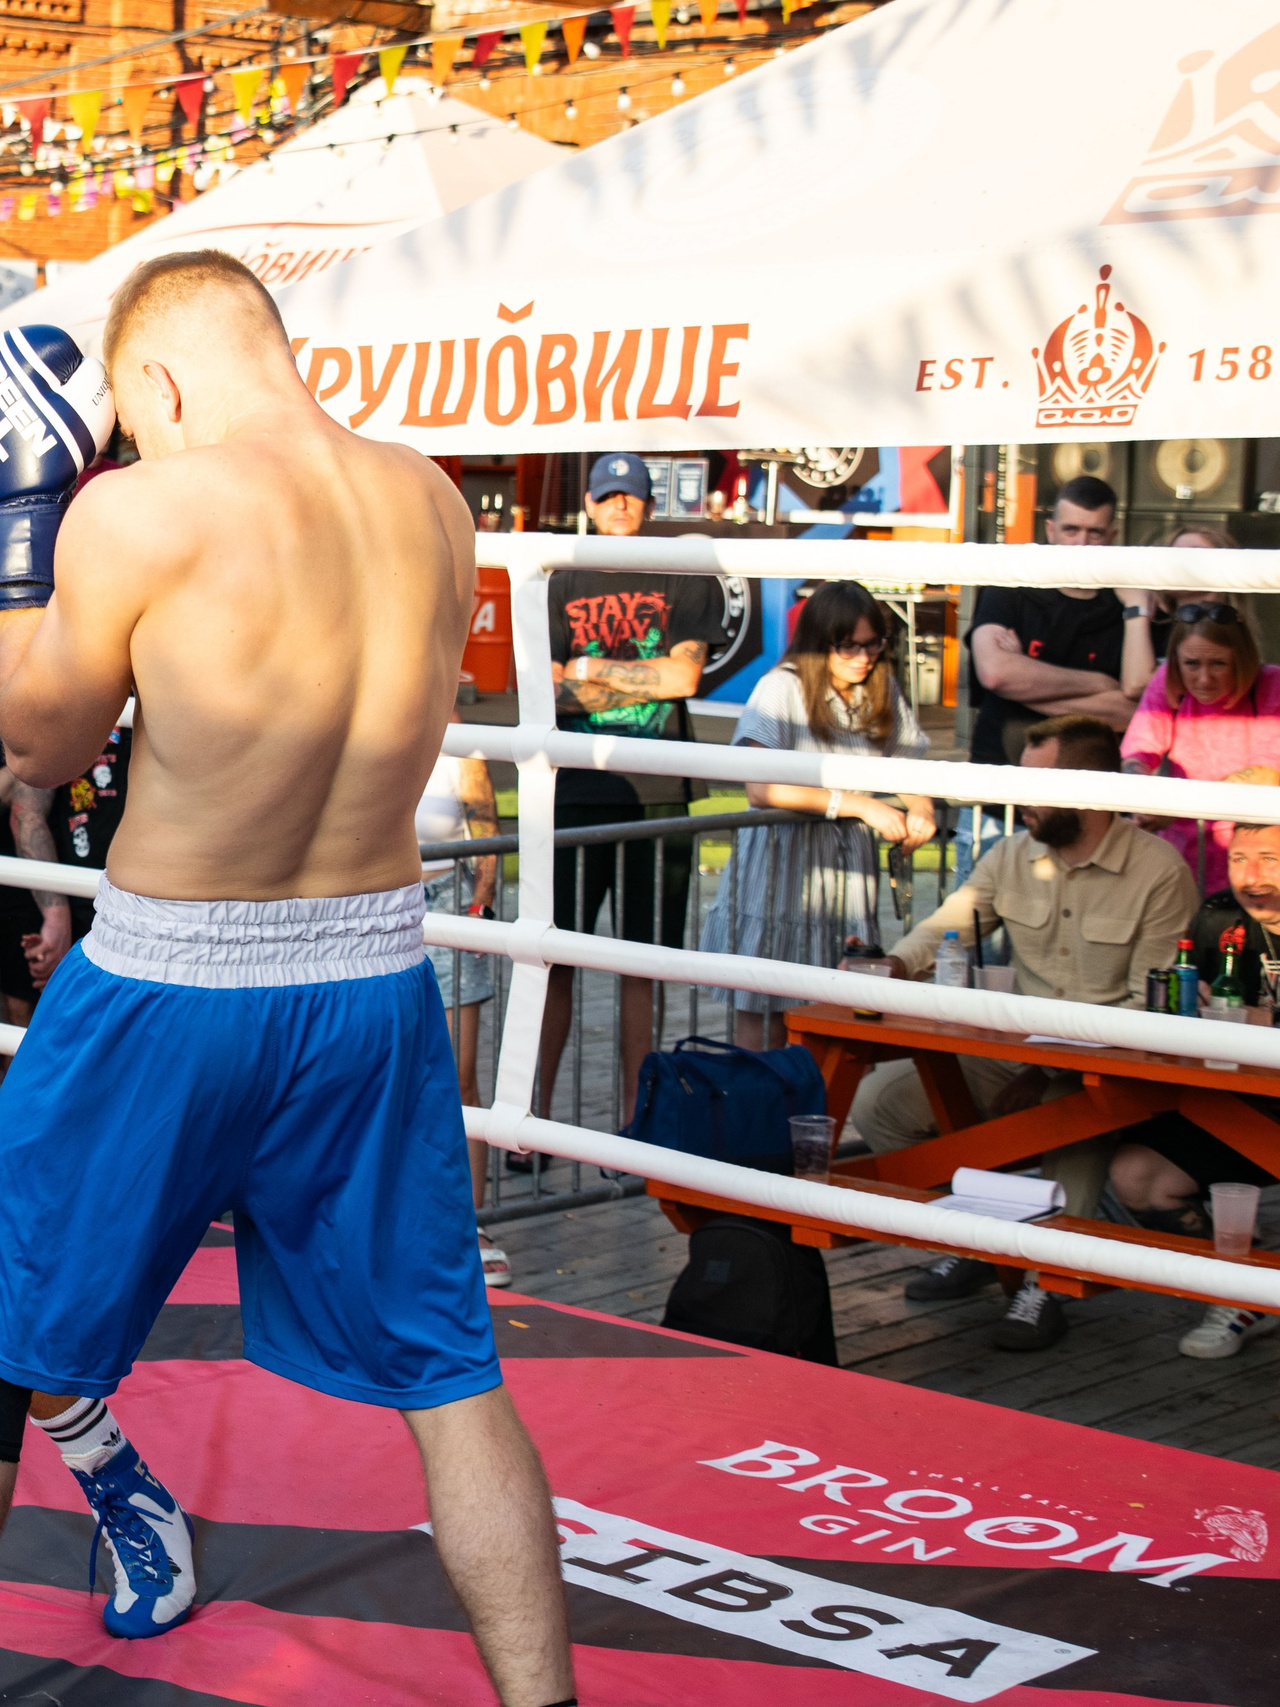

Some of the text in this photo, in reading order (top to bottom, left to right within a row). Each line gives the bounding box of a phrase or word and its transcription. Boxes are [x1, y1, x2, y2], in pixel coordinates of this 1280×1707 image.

[915, 356, 1010, 392] EST.
[565, 591, 646, 629] STAY
[696, 1440, 1238, 1588] BROOM
[798, 1514, 957, 1561] GIN
